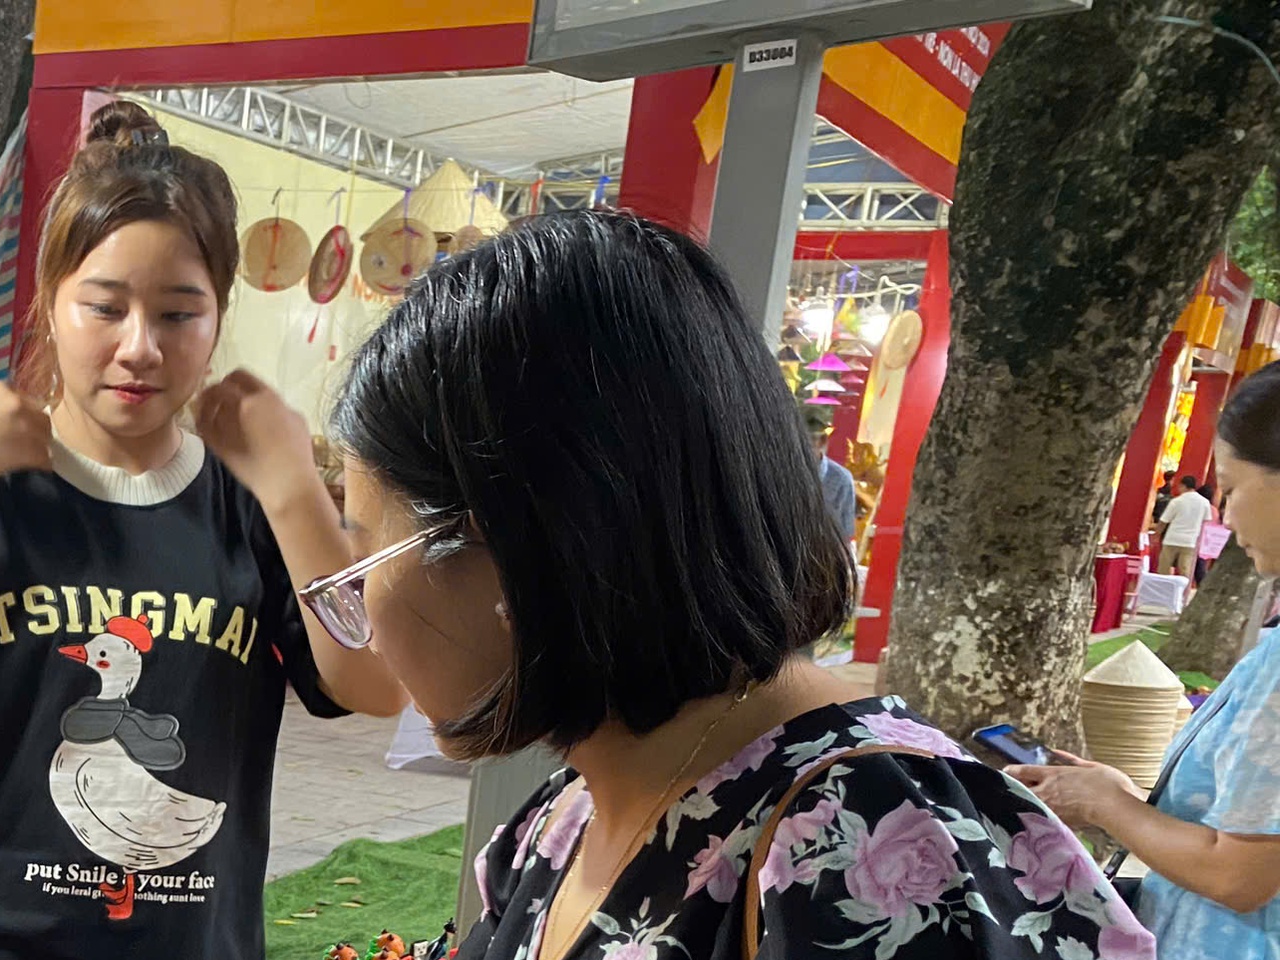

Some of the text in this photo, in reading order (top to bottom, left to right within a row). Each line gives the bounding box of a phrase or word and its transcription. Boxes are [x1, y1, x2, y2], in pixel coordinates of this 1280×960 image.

[23, 863, 63, 881] put
[66, 863, 118, 885] Snile
[137, 874, 186, 892] your
[42, 882, 52, 892] if
[51, 886, 70, 896] you
